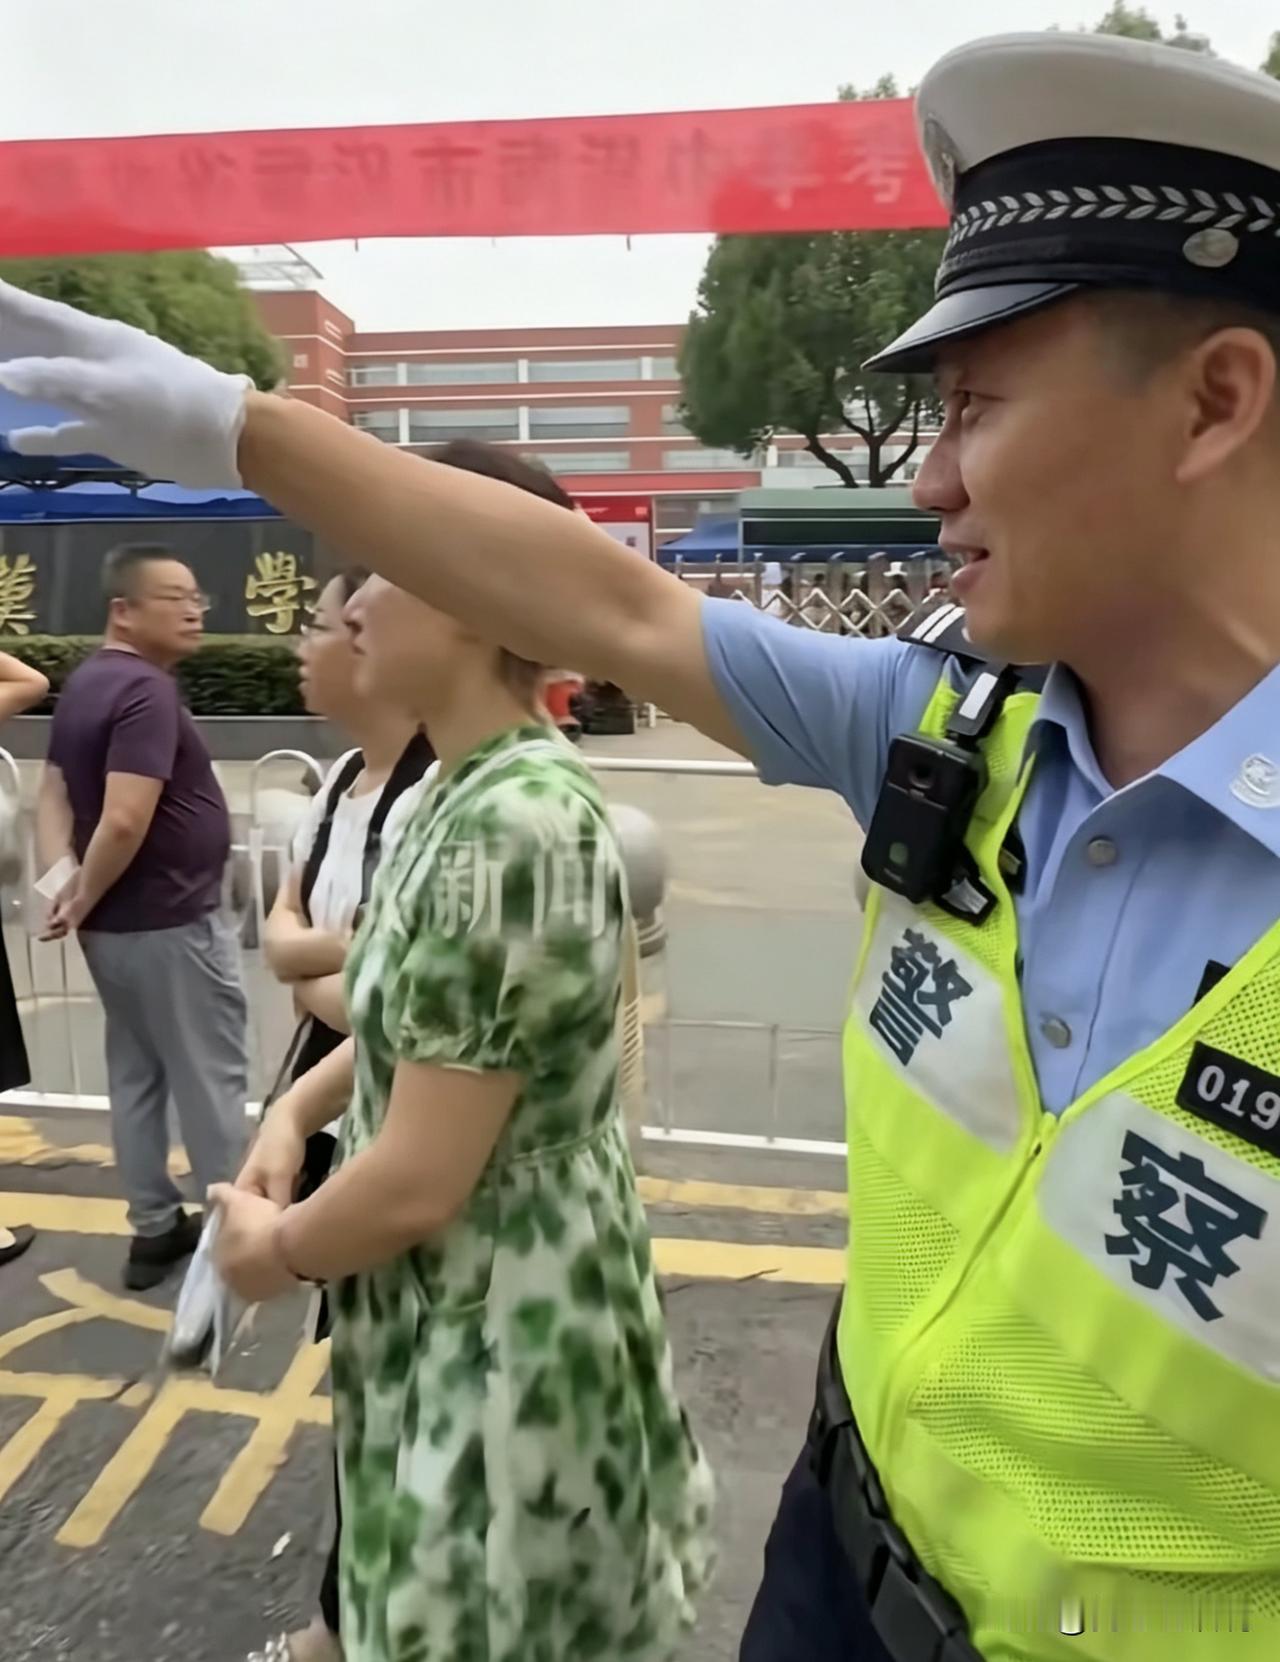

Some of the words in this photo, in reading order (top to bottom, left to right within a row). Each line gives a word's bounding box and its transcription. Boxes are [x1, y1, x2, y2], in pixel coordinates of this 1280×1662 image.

[245, 551, 318, 634] 學
[869, 927, 974, 1067] 警
[1196, 1065, 1280, 1131] 019
[1104, 1129, 1269, 1323] 察
